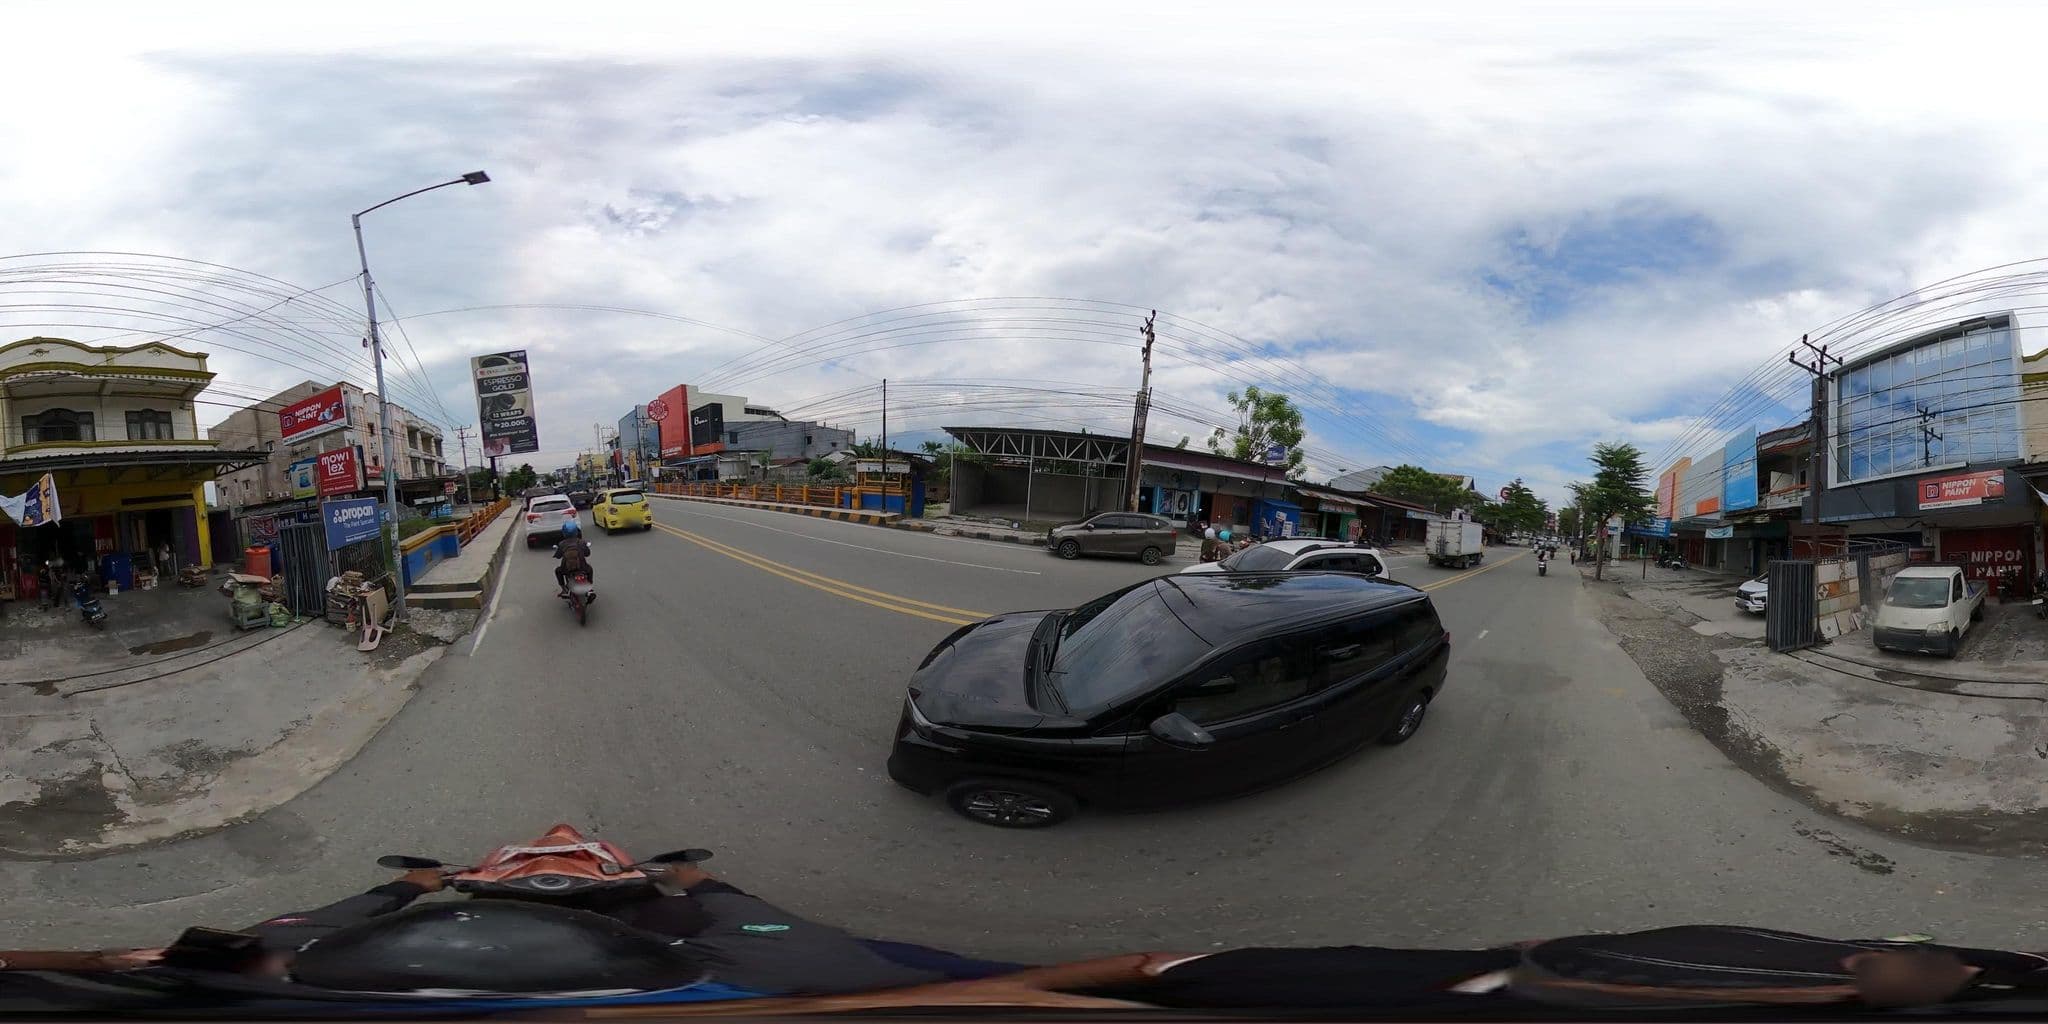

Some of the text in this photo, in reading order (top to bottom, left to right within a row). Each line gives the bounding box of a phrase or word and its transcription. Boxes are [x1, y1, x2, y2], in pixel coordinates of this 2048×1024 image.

[483, 375, 522, 386] ESPRESSO
[492, 383, 515, 392] GOLD
[295, 401, 321, 417] NIPPON
[298, 411, 318, 424] PAINT
[1942, 478, 1977, 490] NIPPON
[1945, 486, 1972, 497] PAINT
[342, 506, 374, 522] propan
[1971, 549, 2023, 563] NIPPON
